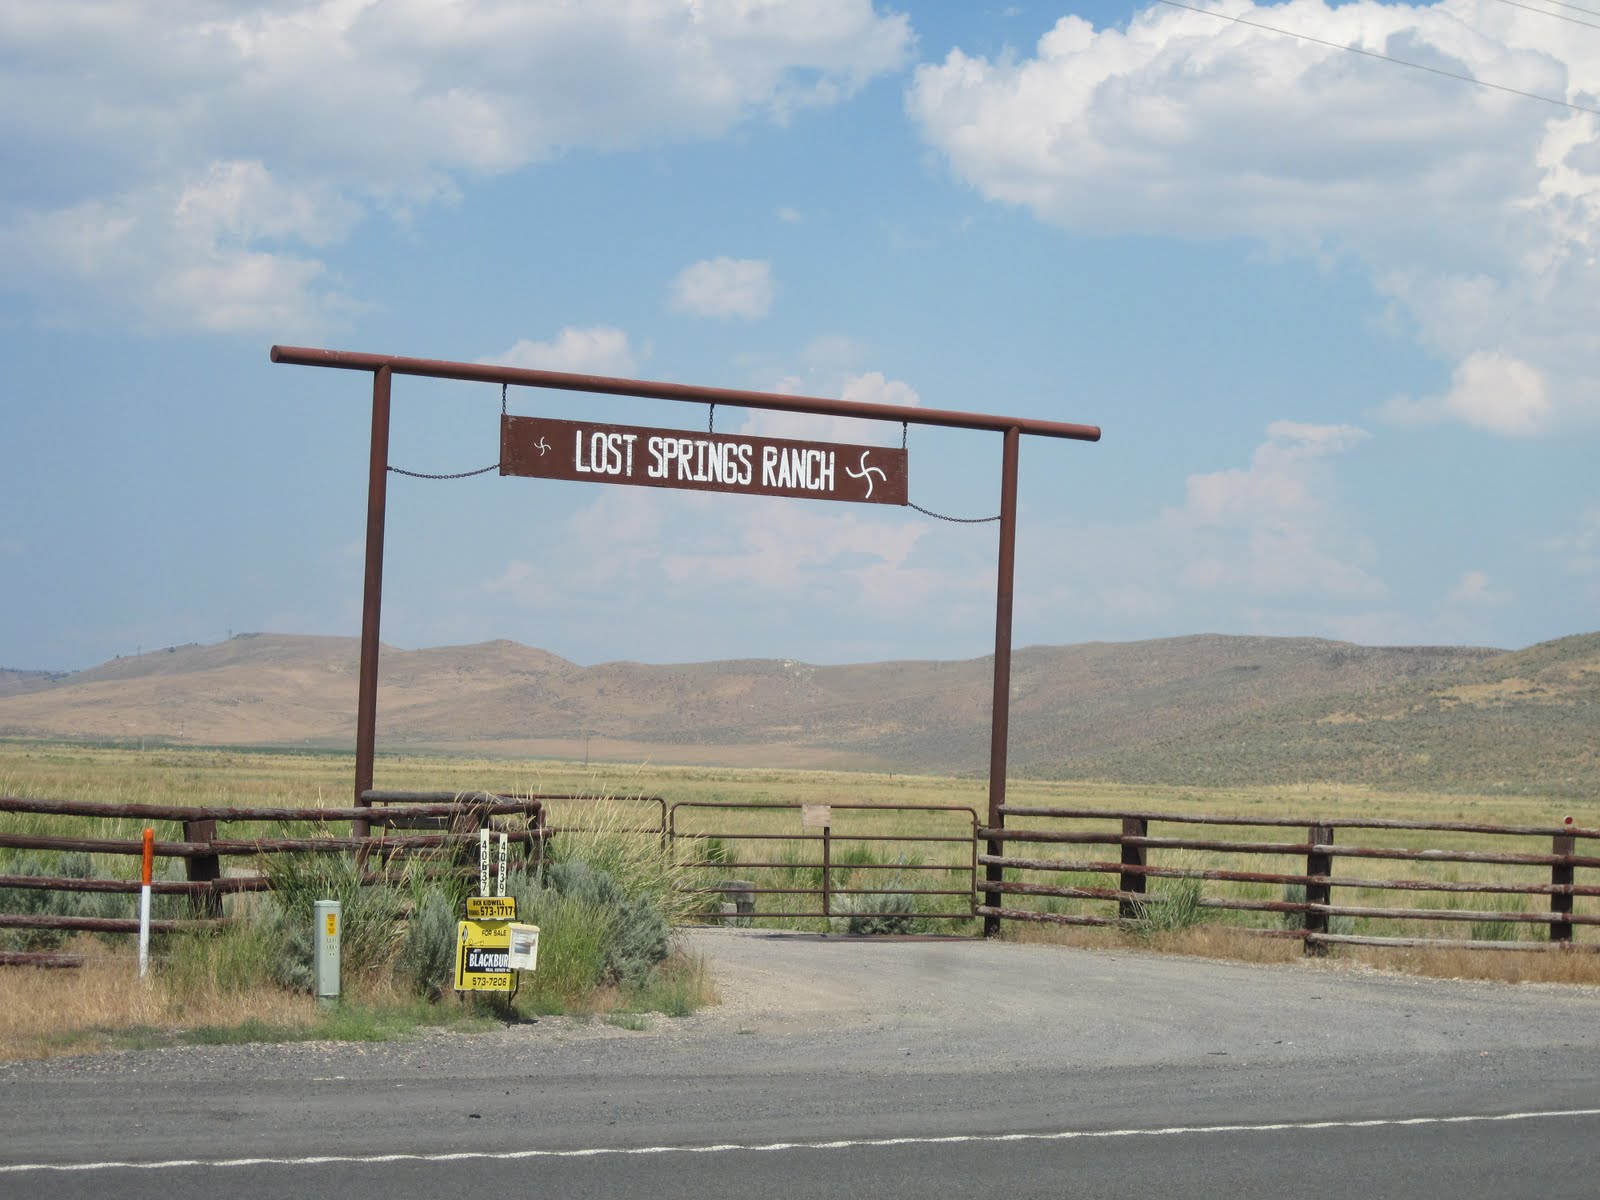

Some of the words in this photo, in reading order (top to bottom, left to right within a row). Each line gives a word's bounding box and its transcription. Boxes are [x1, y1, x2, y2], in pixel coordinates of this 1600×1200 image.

[576, 430, 638, 477] LOST
[647, 436, 752, 485] SPRINGS
[762, 446, 835, 491] RANCH
[480, 906, 513, 916] 573-1717
[469, 953, 509, 967] BLACKBUR
[472, 977, 507, 986] 573-7206
